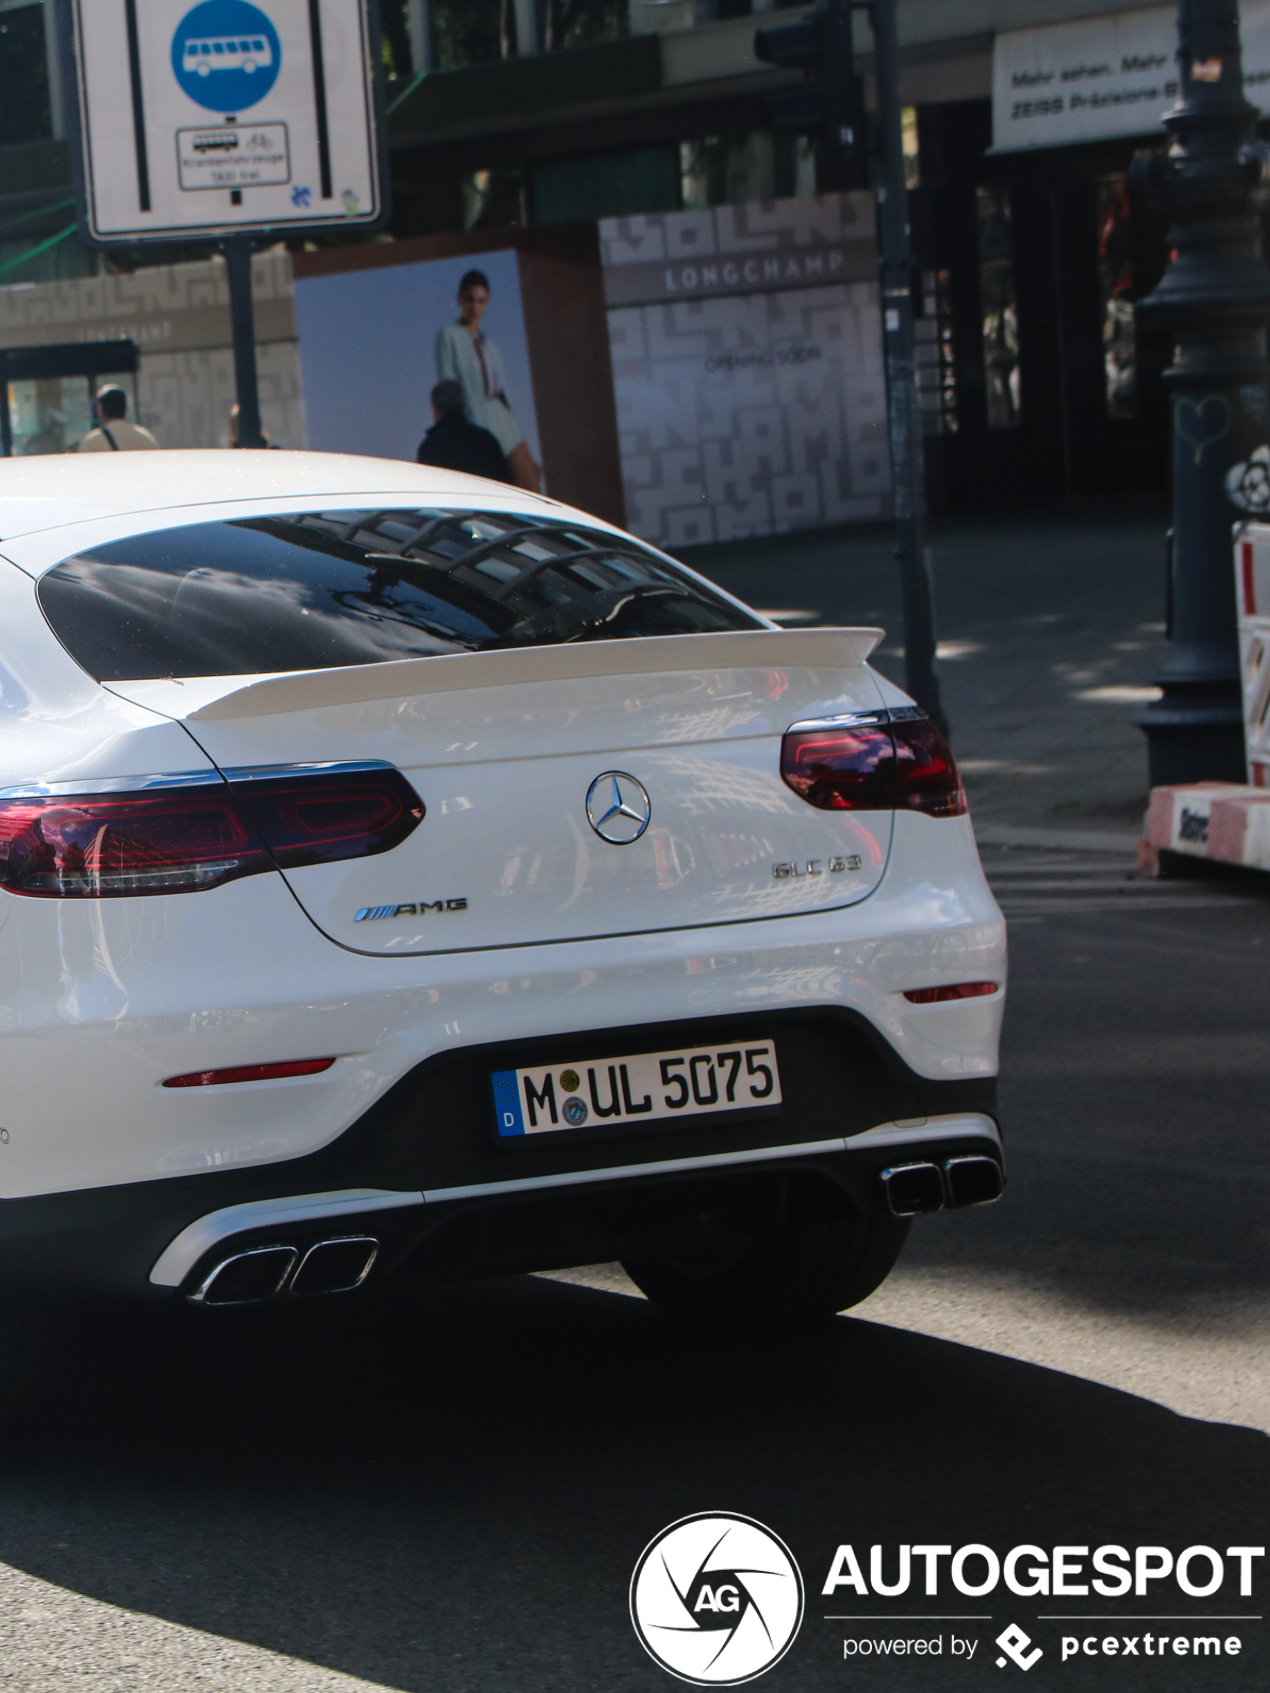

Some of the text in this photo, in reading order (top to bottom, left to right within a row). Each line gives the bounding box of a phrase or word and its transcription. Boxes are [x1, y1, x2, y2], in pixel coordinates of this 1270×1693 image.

[1011, 71, 1054, 89] Mehr
[1120, 54, 1167, 73] Mehr
[1012, 97, 1064, 119] ZEISS
[665, 253, 844, 291] LONGCHAMP
[704, 351, 775, 373] OPENING
[772, 854, 862, 879] GLC 63
[393, 898, 468, 917] AMG
[523, 1047, 774, 1127] M UL 5075
[503, 1112, 515, 1128] D
